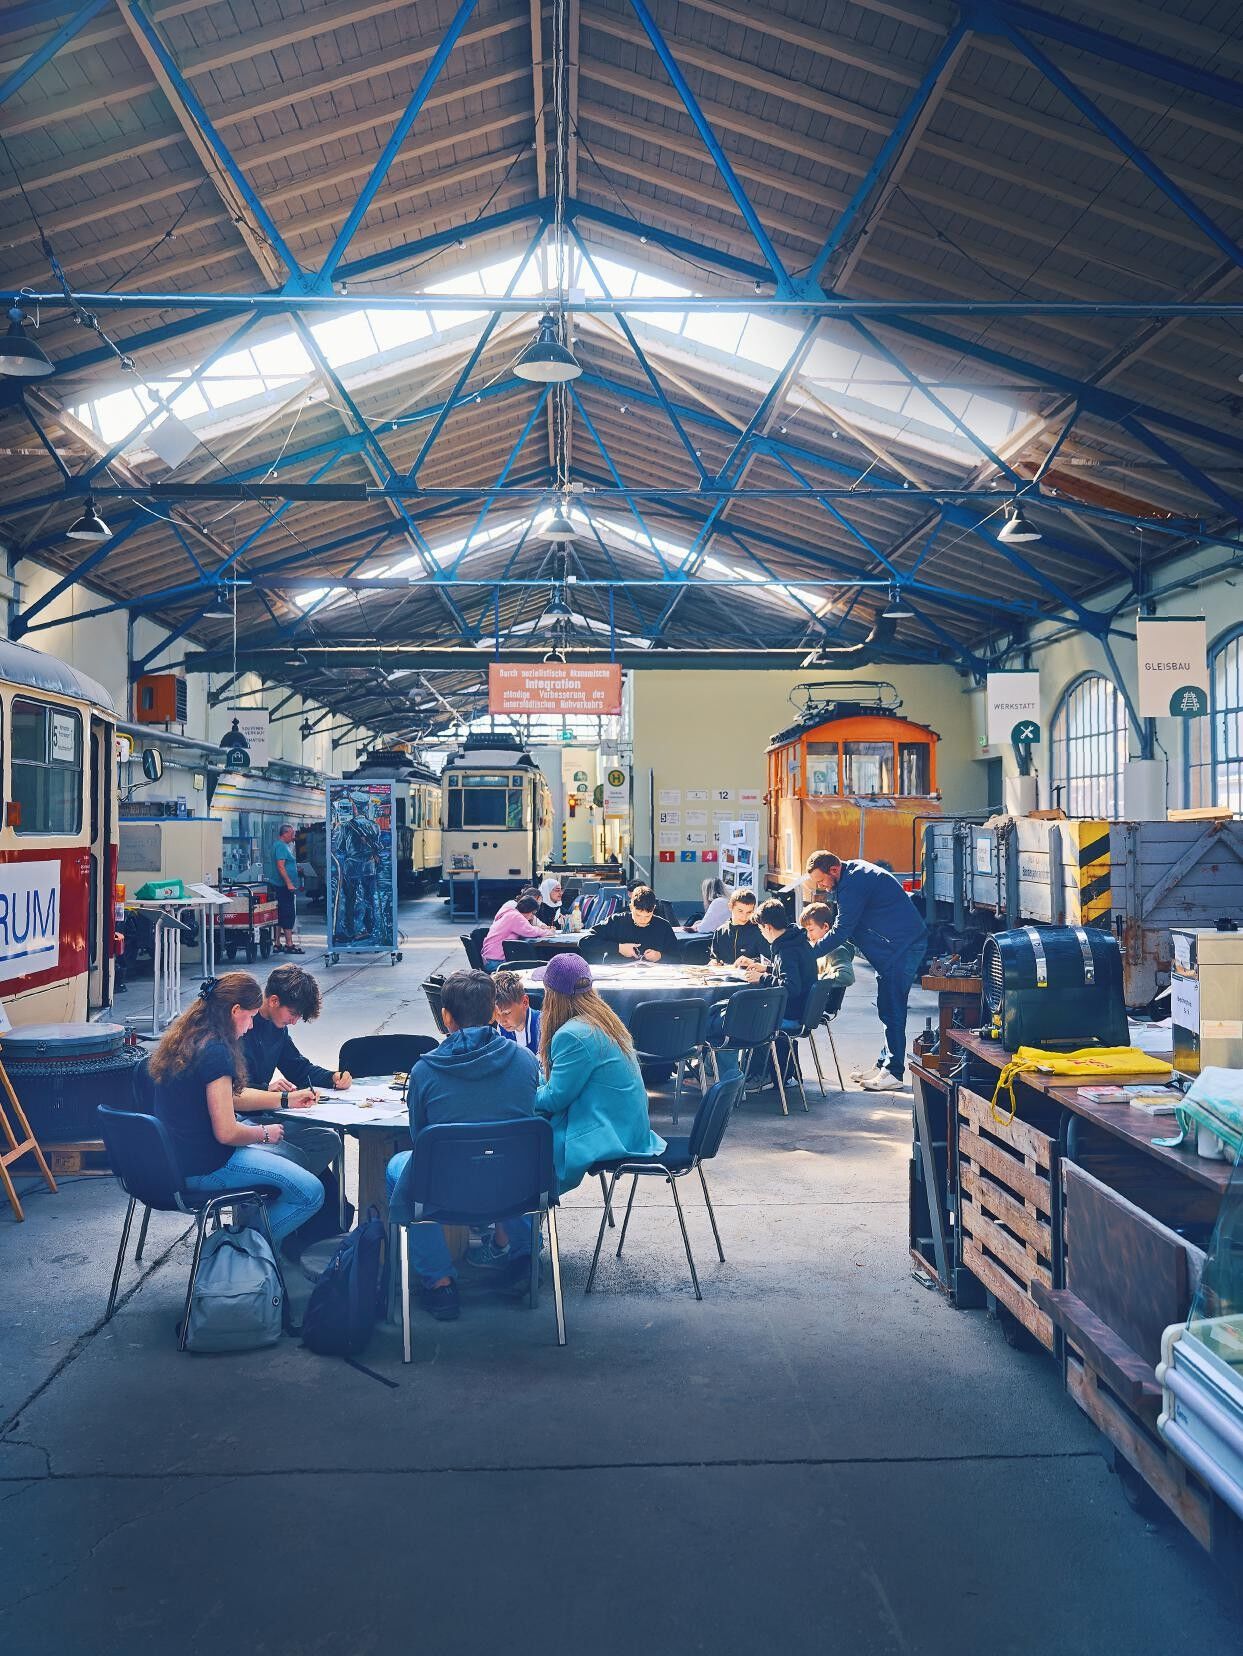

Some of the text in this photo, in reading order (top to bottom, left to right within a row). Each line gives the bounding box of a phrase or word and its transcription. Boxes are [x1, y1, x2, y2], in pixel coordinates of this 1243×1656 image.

[1144, 662, 1191, 671] GLEISBAU
[499, 669, 518, 678] Durch
[525, 679, 581, 691] Integration
[539, 690, 586, 700] Verbesserung
[53, 725, 58, 747] 5
[513, 776, 520, 785] 3
[612, 773, 620, 784] H
[719, 791, 729, 800] 12
[661, 813, 667, 822] 5
[686, 833, 692, 841] 4
[665, 853, 670, 861] 1
[685, 853, 692, 861] 2
[706, 852, 713, 861] 4
